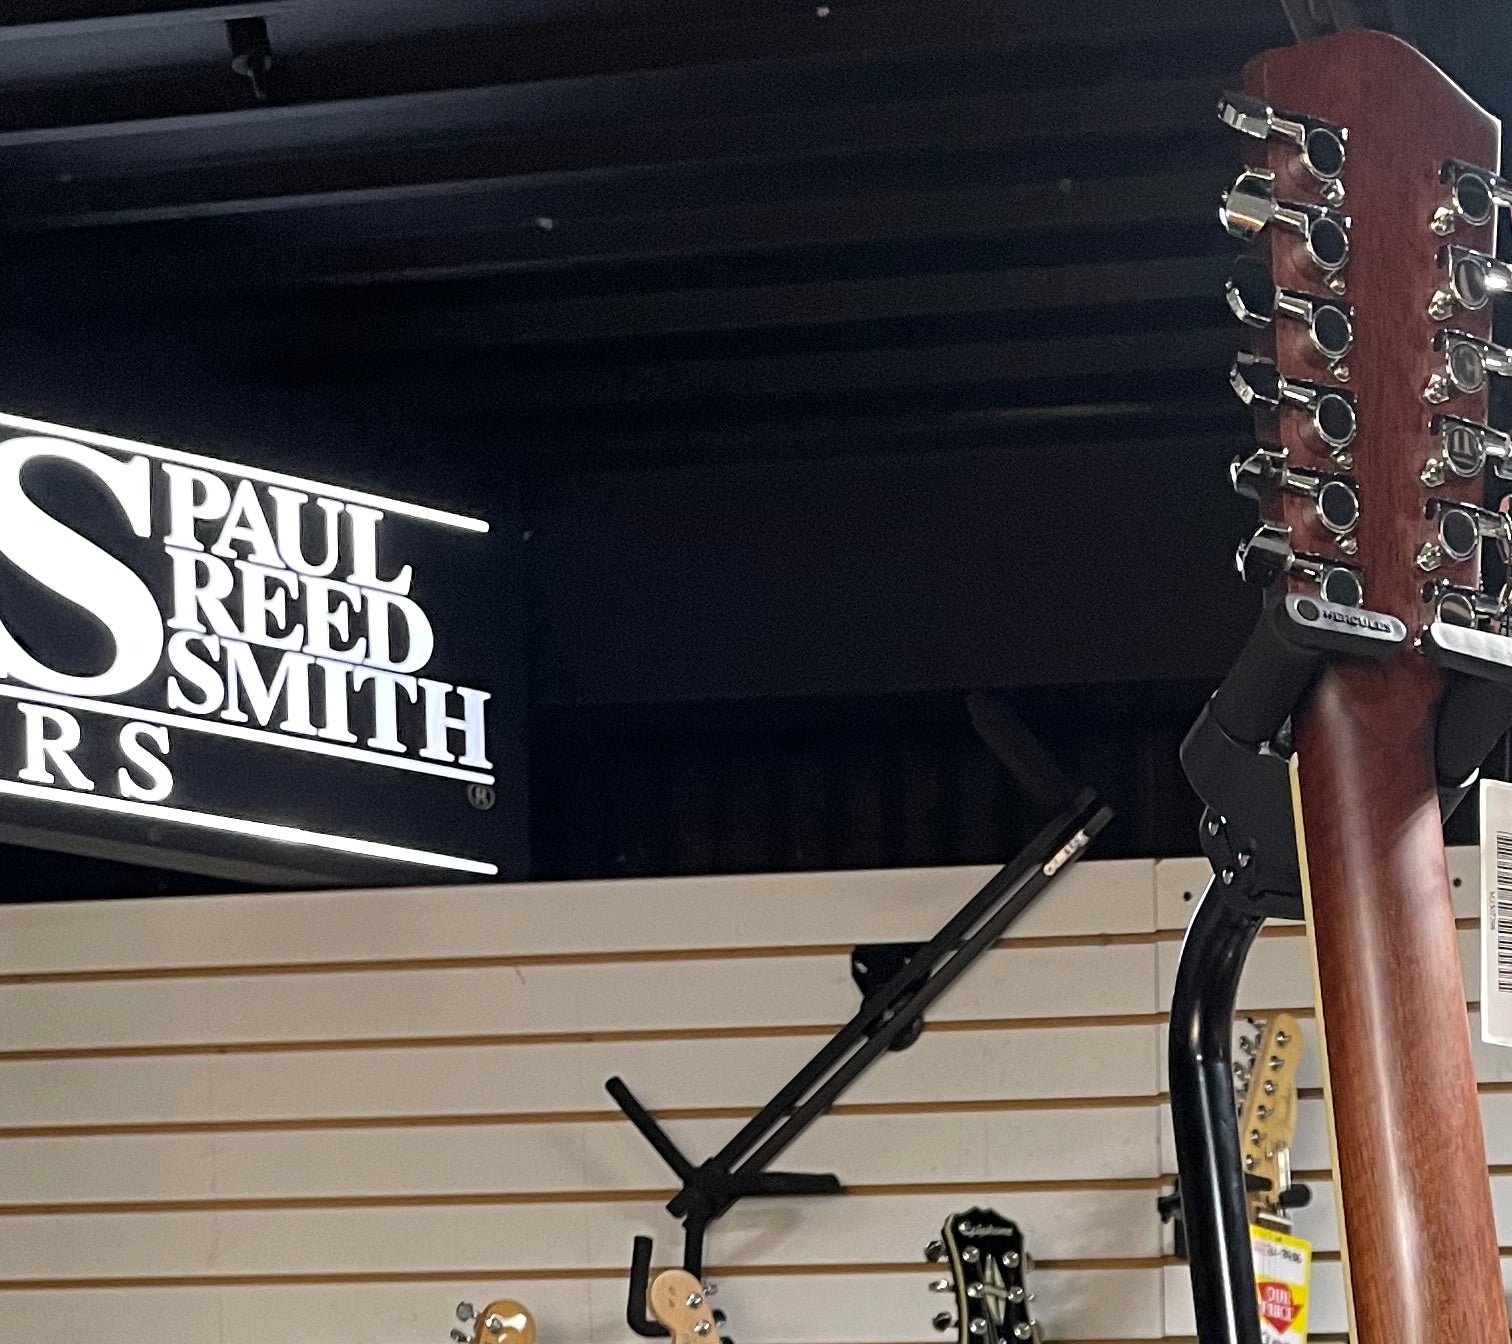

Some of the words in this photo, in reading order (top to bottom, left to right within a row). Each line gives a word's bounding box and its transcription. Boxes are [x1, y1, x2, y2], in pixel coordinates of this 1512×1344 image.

[162, 462, 412, 596] PAUL
[165, 545, 435, 676] REED
[167, 632, 494, 770] SMITH
